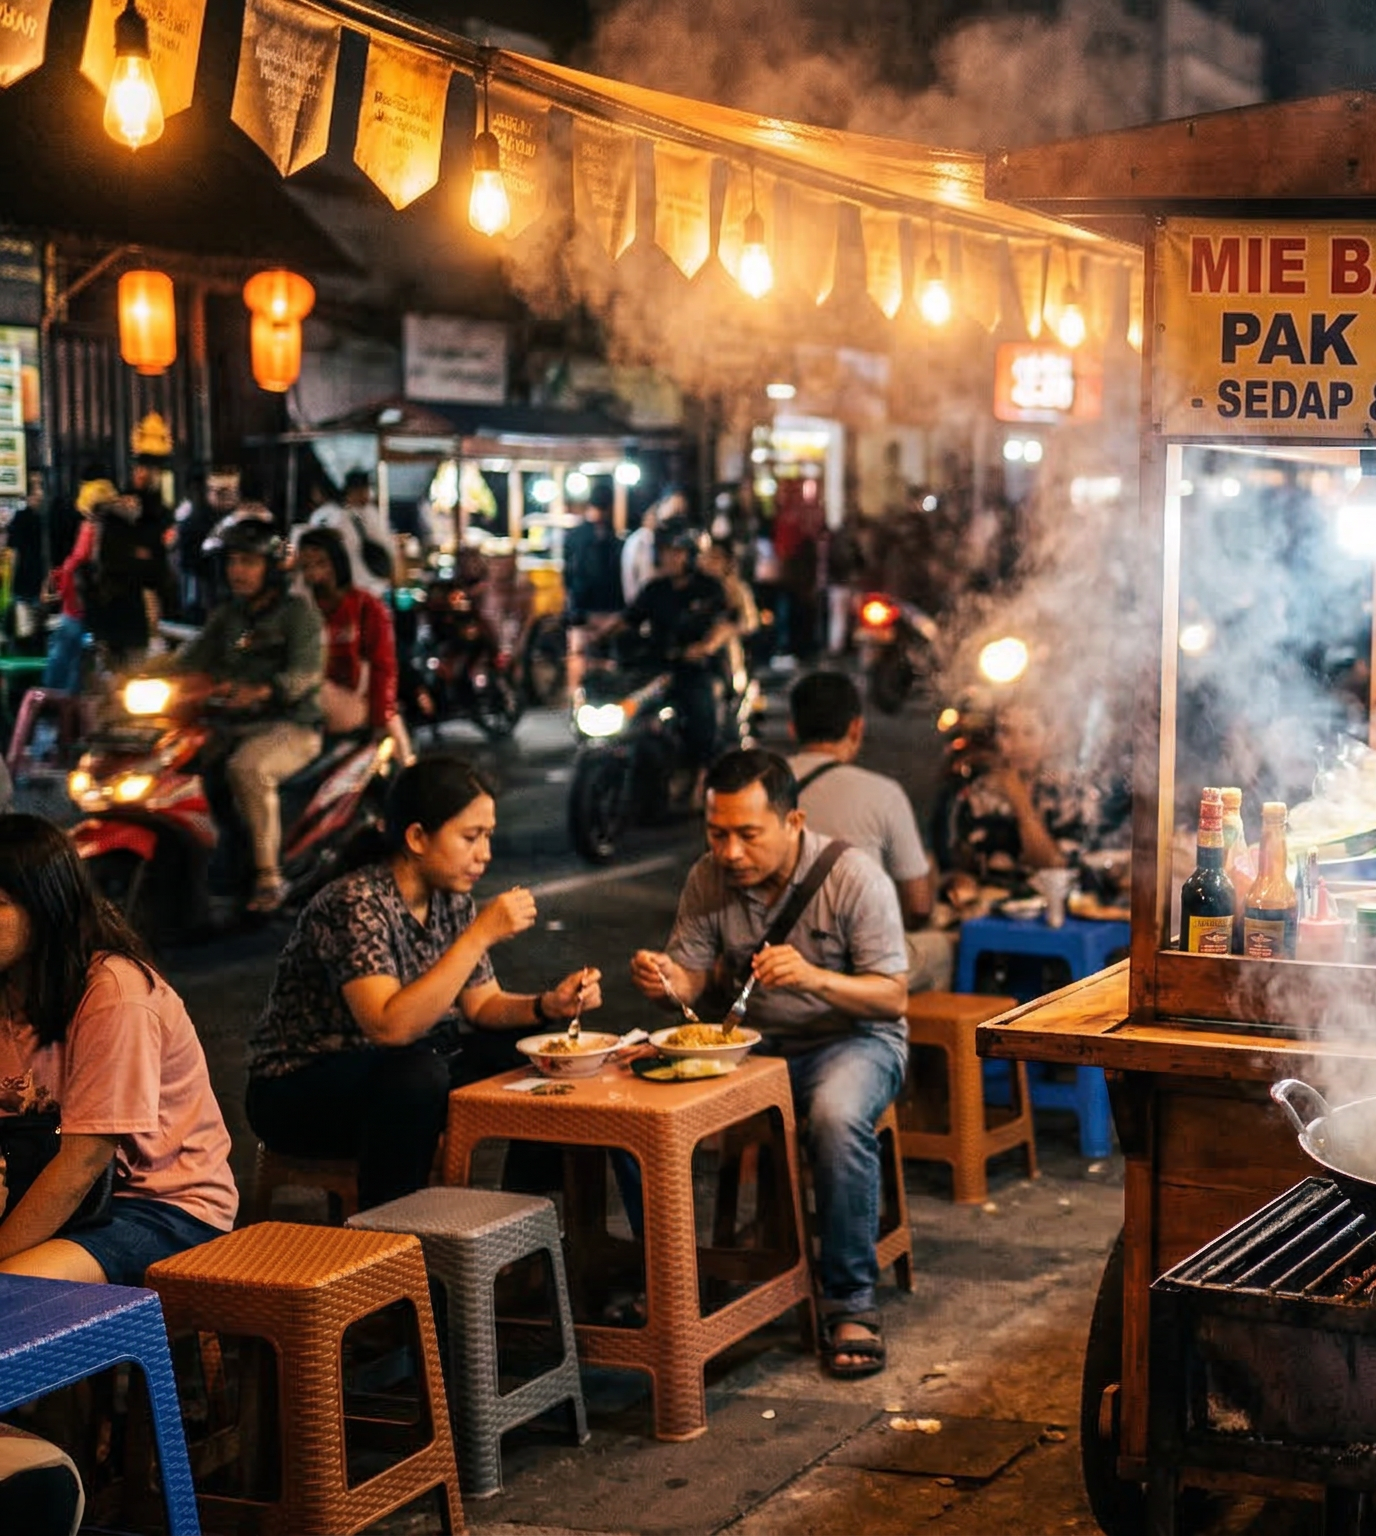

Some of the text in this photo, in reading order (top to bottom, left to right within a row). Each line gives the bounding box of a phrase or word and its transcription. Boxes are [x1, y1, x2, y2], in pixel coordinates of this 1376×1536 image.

[1190, 237, 1307, 294] MIE
[1220, 312, 1357, 365] PAK
[1217, 380, 1354, 420] SEDAP
